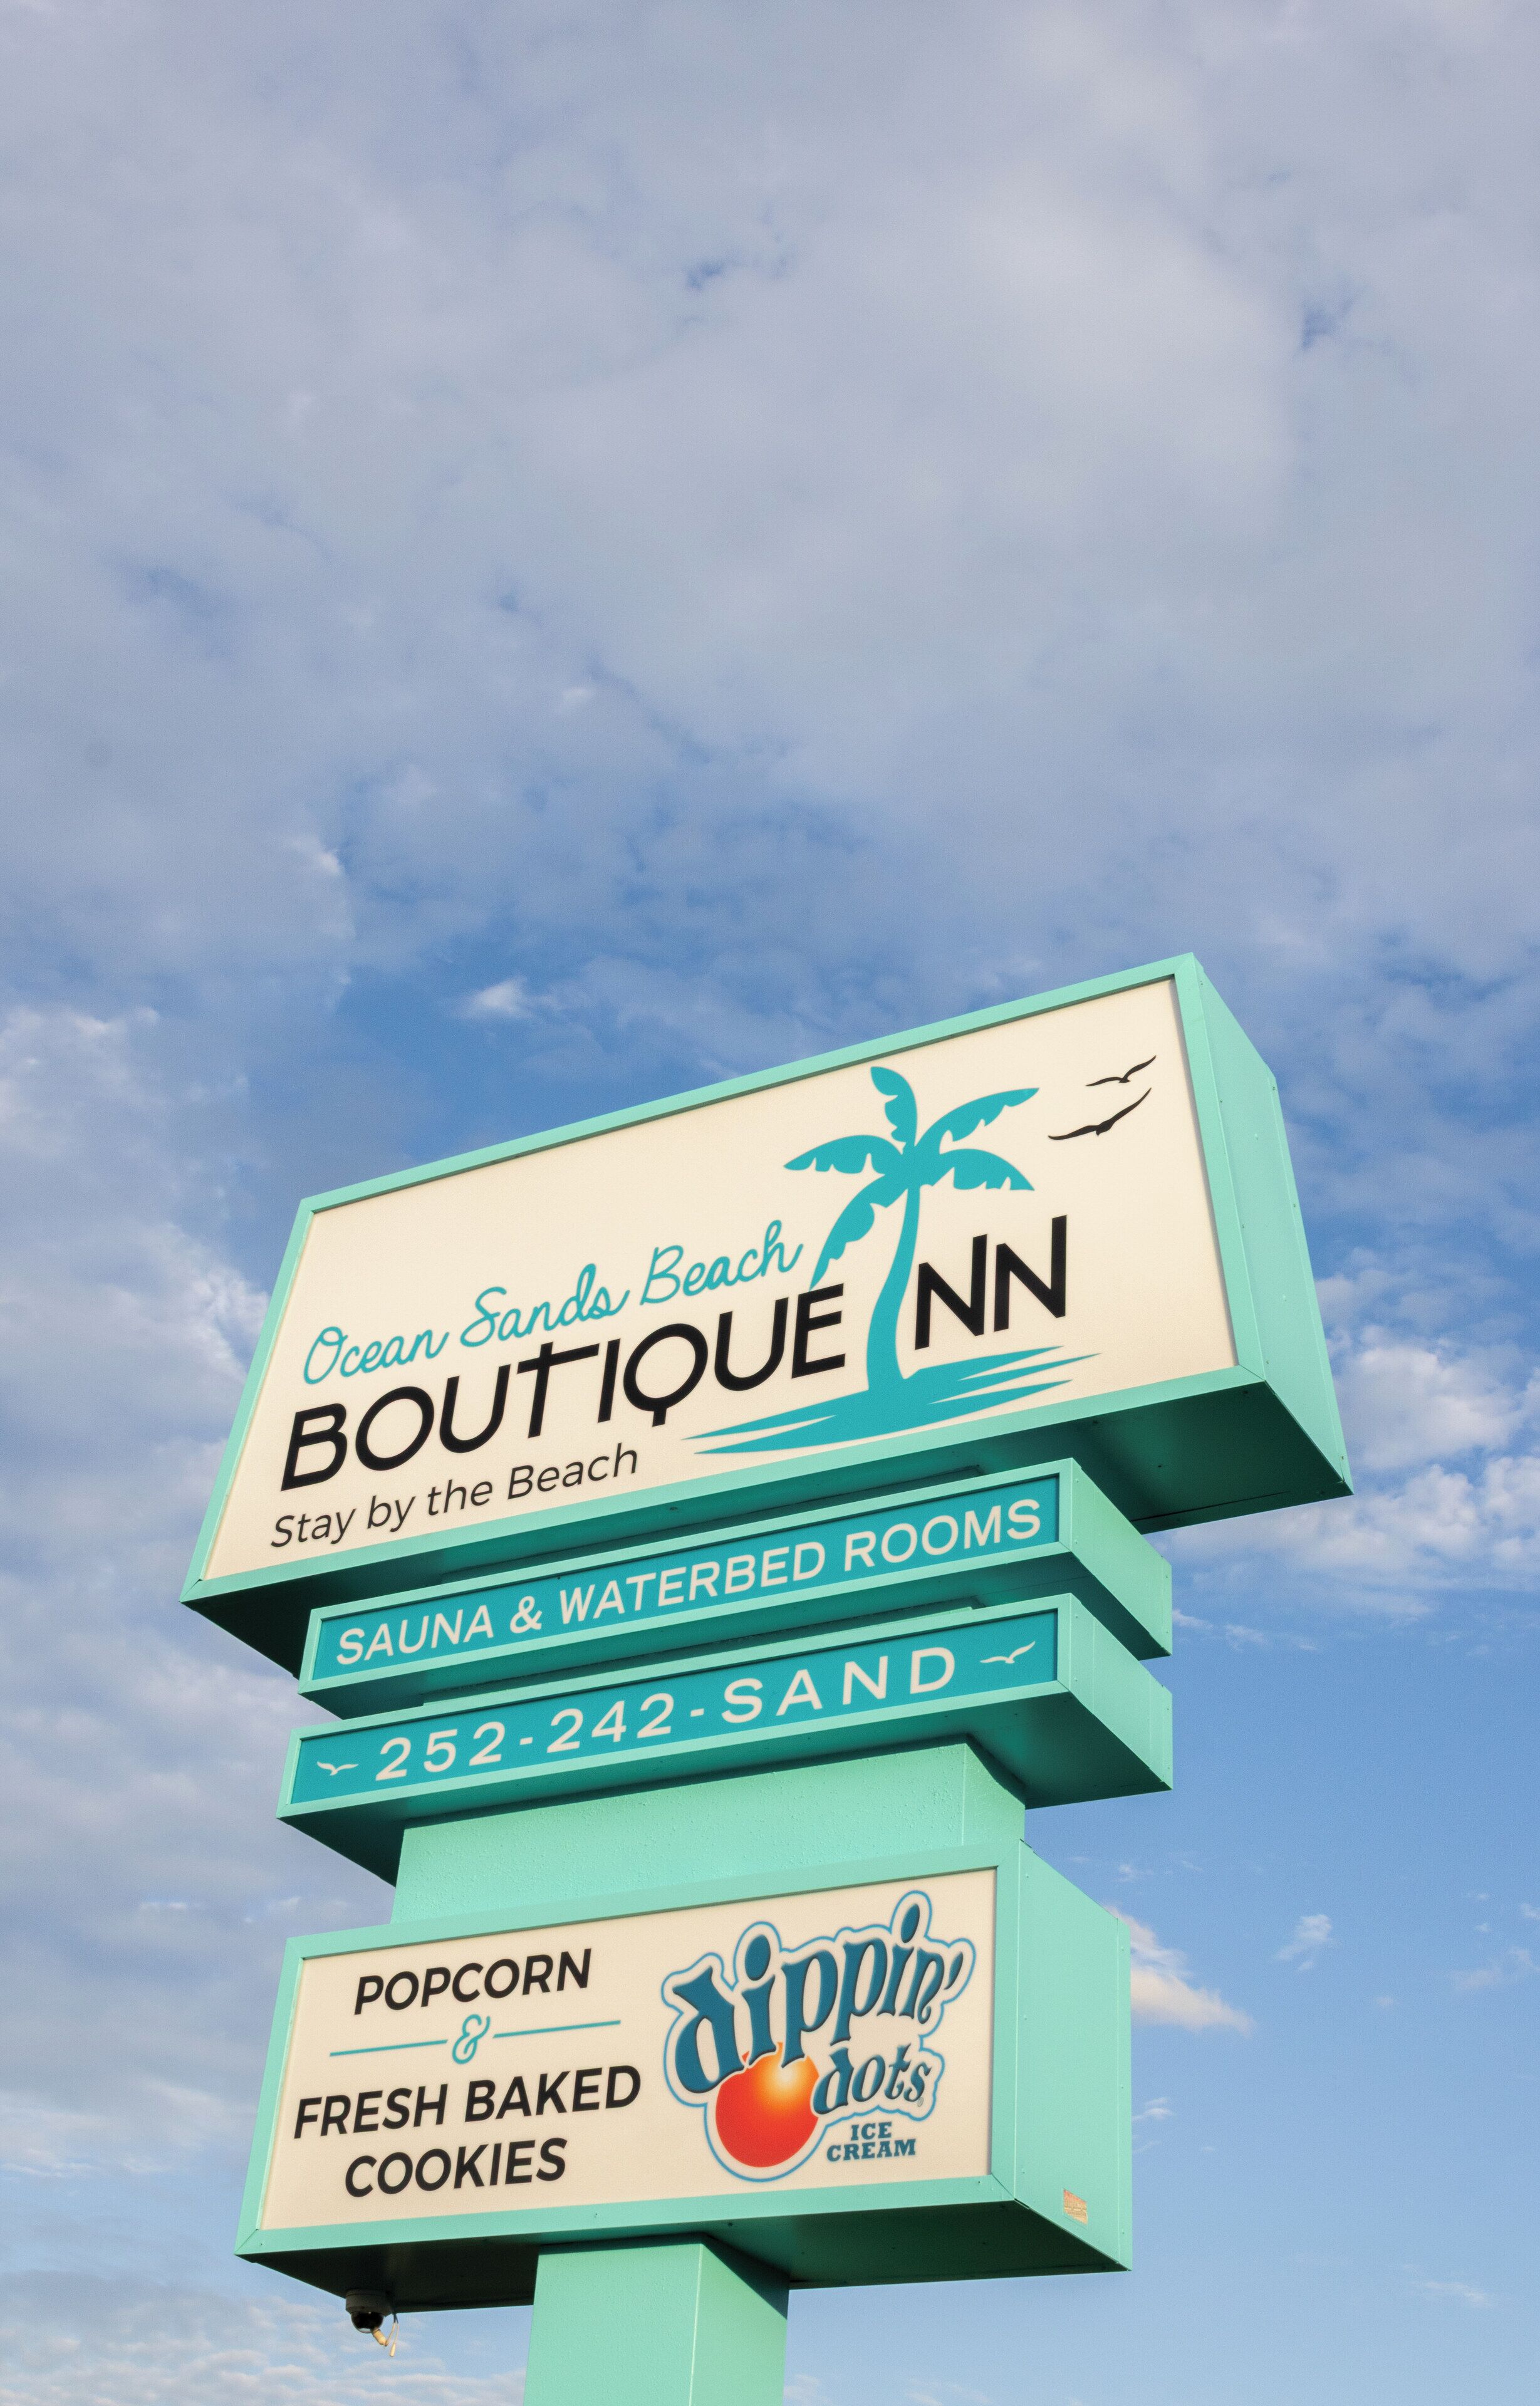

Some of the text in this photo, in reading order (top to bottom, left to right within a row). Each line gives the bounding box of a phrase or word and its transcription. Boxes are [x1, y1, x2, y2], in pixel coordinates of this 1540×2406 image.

[303, 1219, 804, 1385] Ocean Sands Beach
[280, 1283, 846, 1491] BOUTIQUE
[270, 1442, 638, 1548] Stay by the Beach
[336, 1498, 1041, 1665] SAUNA & WATERBED ROOMS
[354, 1948, 592, 2015] POPCORN
[451, 2014, 491, 2064] &
[294, 2065, 641, 2139] FRESH BAKED
[813, 2043, 933, 2115] dots
[345, 2137, 568, 2197] COOKIES
[826, 2138, 917, 2162] CREAM
[850, 2122, 893, 2141] ICE
